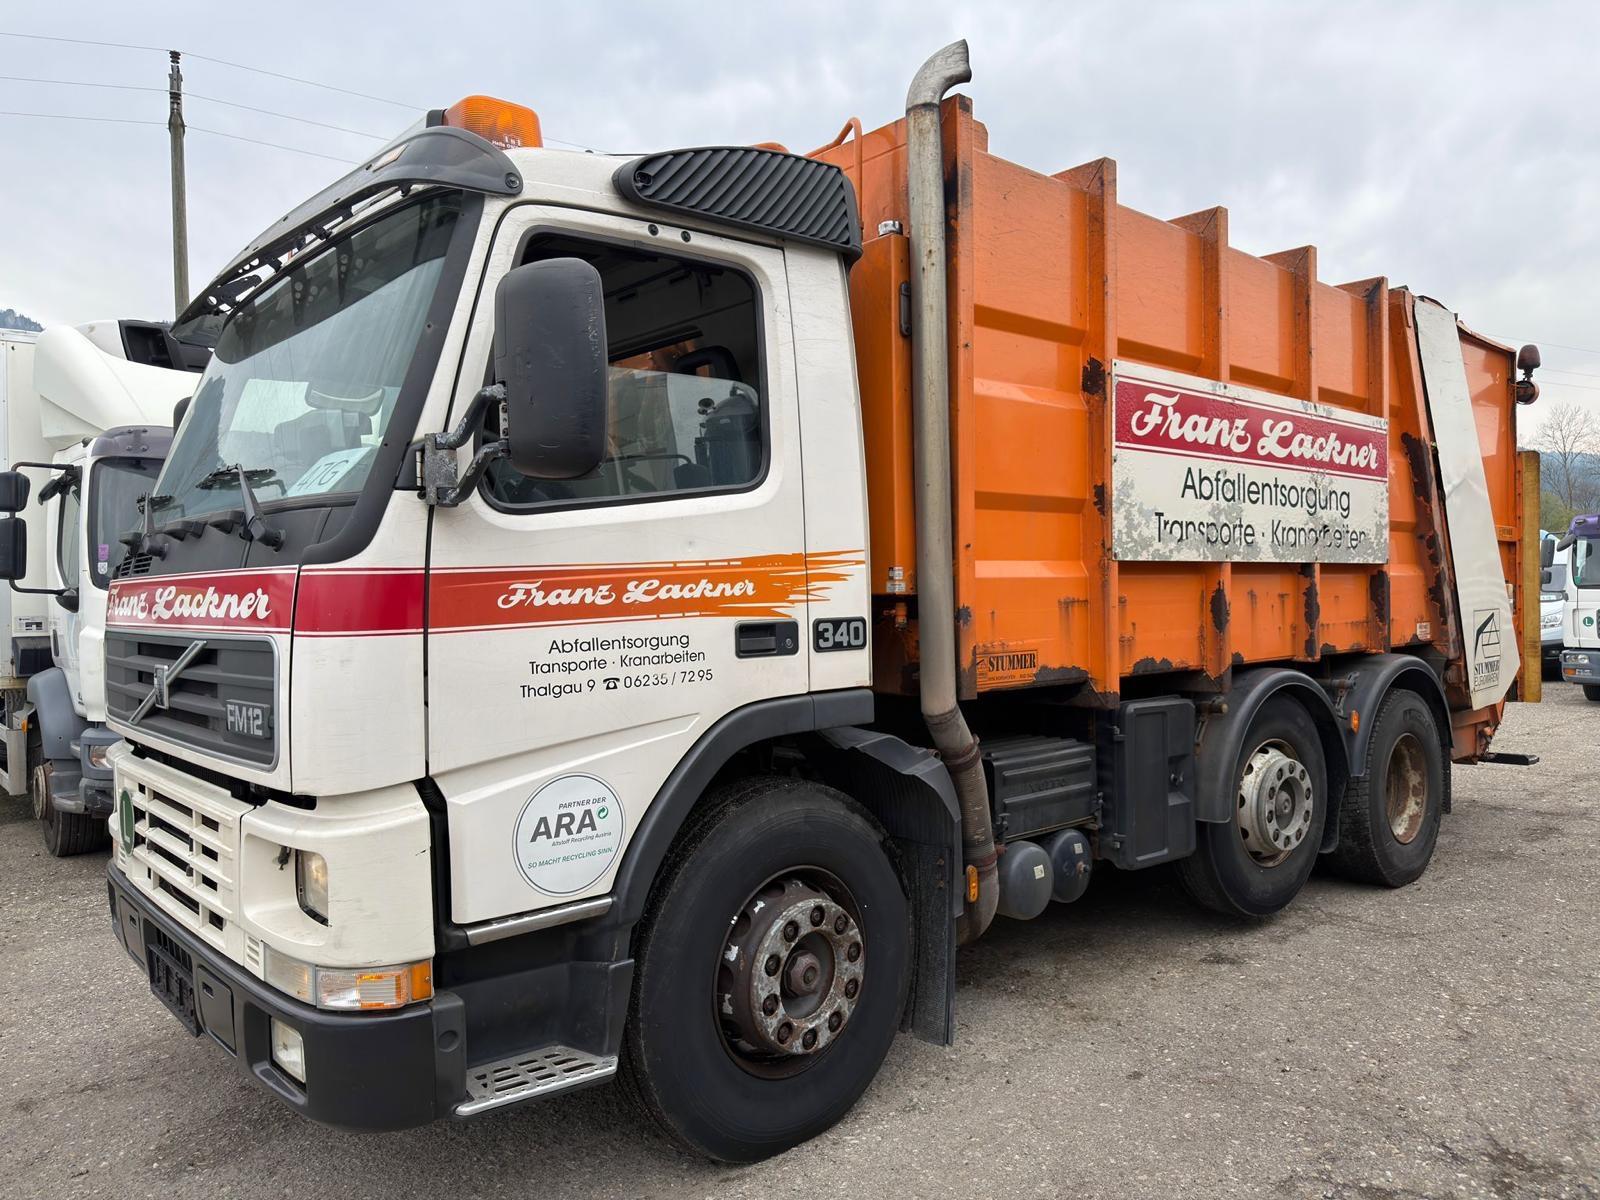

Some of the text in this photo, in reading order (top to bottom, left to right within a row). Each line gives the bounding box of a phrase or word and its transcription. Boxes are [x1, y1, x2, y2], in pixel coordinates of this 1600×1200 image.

[1131, 392, 1378, 470] Franz Lackner
[1181, 467, 1350, 519] Abfallentsorgung
[1155, 512, 1255, 546] Transporte
[107, 585, 272, 620] Franz Lackner
[497, 579, 756, 609] Franz Lackner
[548, 634, 690, 655] Abfallentsorgung
[818, 621, 864, 648] 340
[529, 650, 705, 675] Transporte Kranarbeiten
[988, 653, 1036, 672] STUMMER
[520, 683, 582, 698] Thalgau
[587, 679, 596, 692] 9
[226, 704, 263, 736] FM12
[558, 796, 607, 810] PARTNER DER
[529, 808, 597, 843] ARA
[570, 834, 594, 844] Recycling
[538, 857, 561, 867] MACHT
[562, 850, 597, 863] RECYCLING
